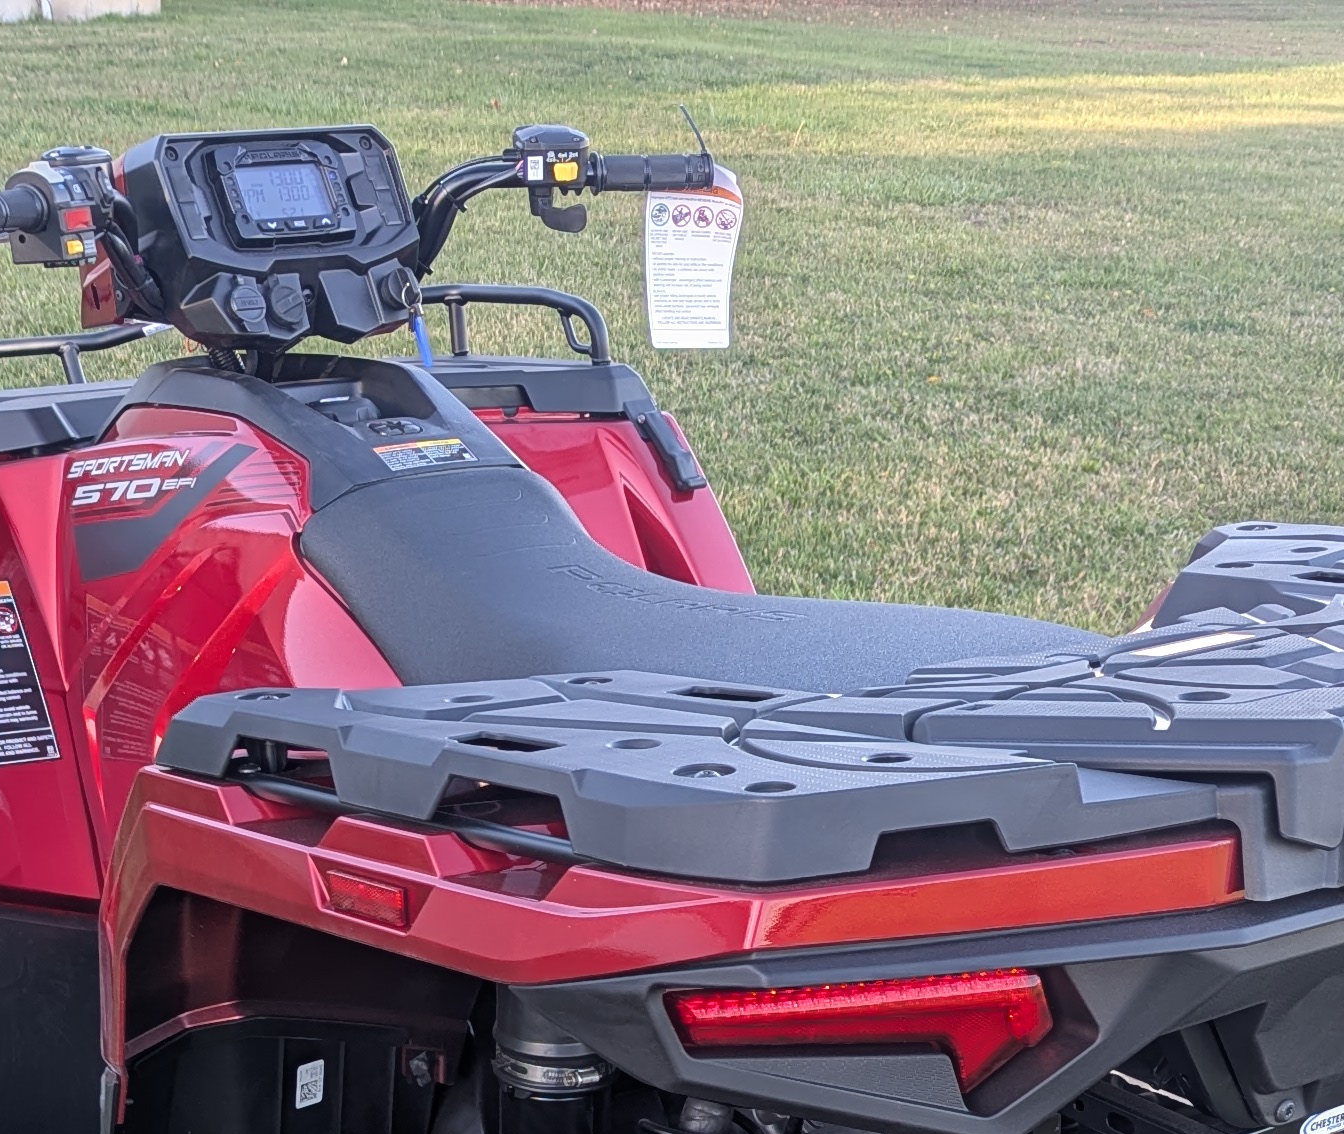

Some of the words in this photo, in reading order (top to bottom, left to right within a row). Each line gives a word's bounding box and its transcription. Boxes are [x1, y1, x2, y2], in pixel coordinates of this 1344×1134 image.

[278, 184, 311, 202] 1300
[66, 449, 191, 479] SPORTSMAN
[72, 477, 161, 506] 570
[161, 477, 198, 491] EFI
